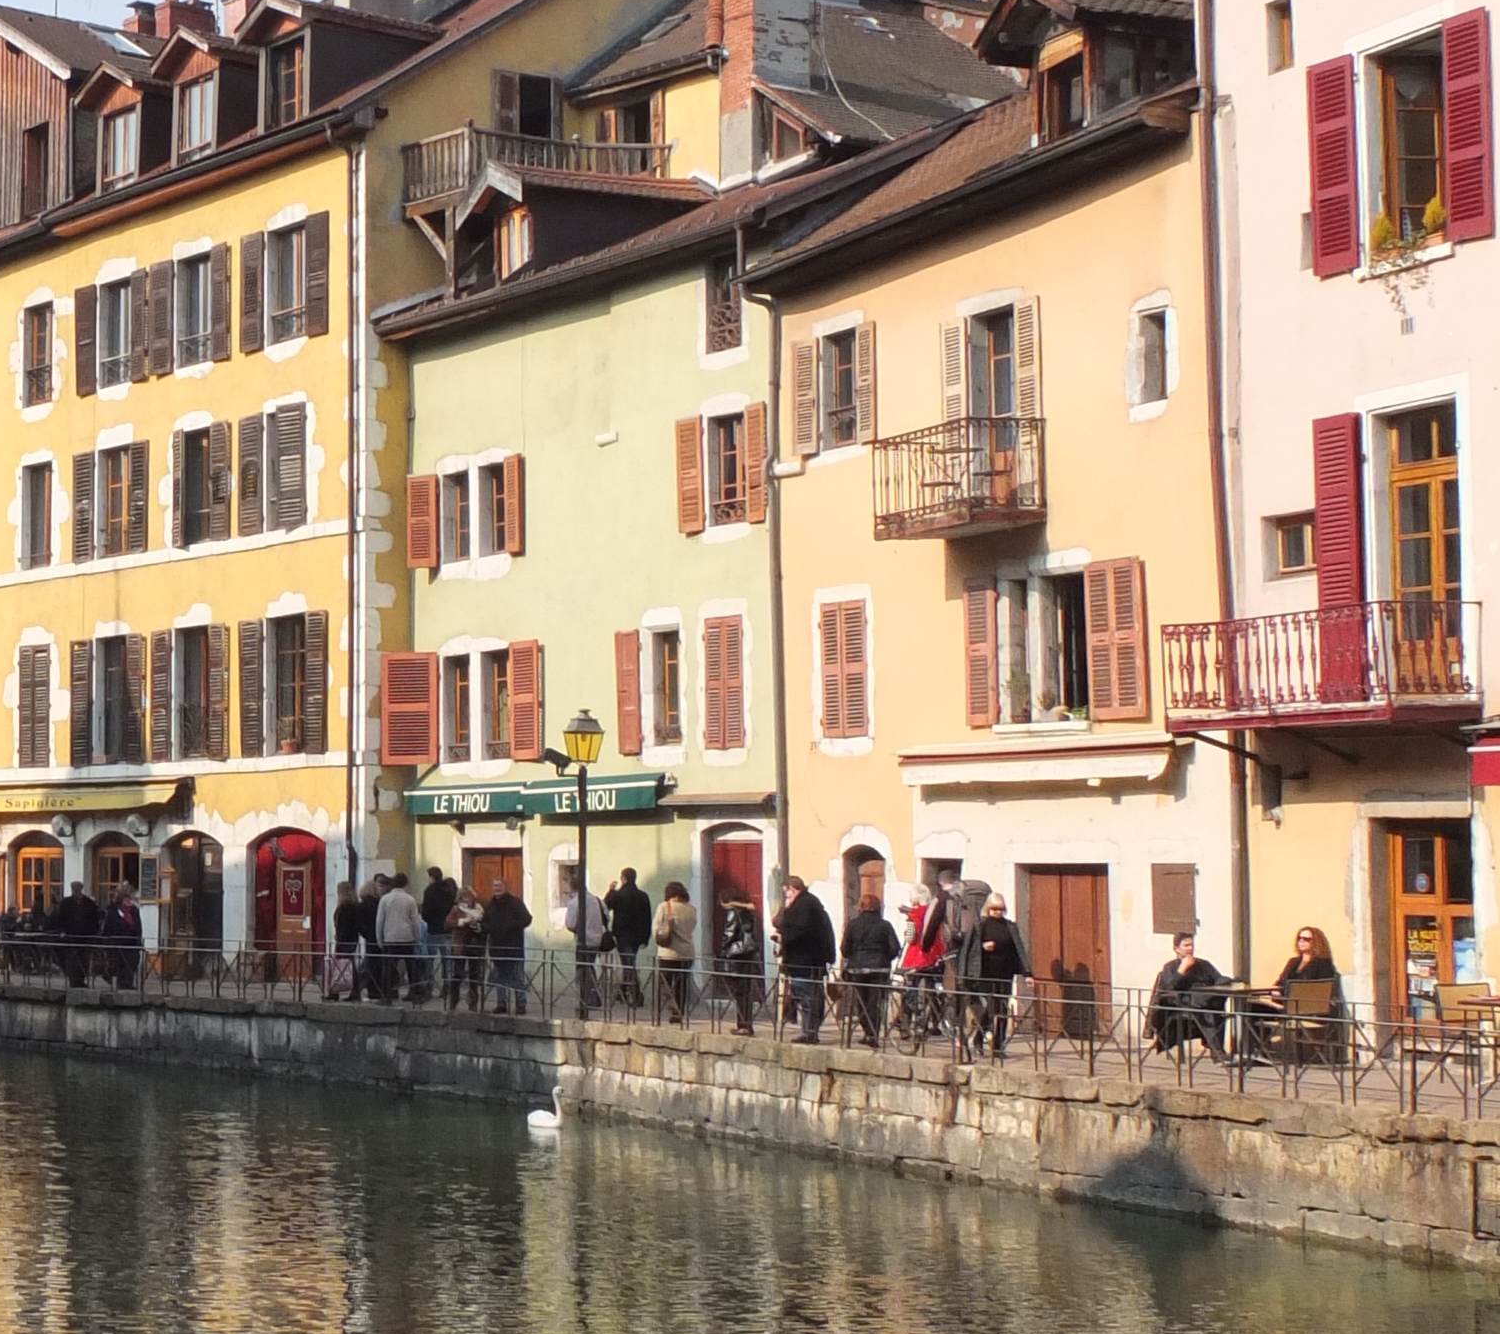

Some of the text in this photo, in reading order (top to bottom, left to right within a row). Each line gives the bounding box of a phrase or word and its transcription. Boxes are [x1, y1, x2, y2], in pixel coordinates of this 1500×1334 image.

[433, 793, 490, 813] LE THIOU
[554, 793, 571, 813] LE
